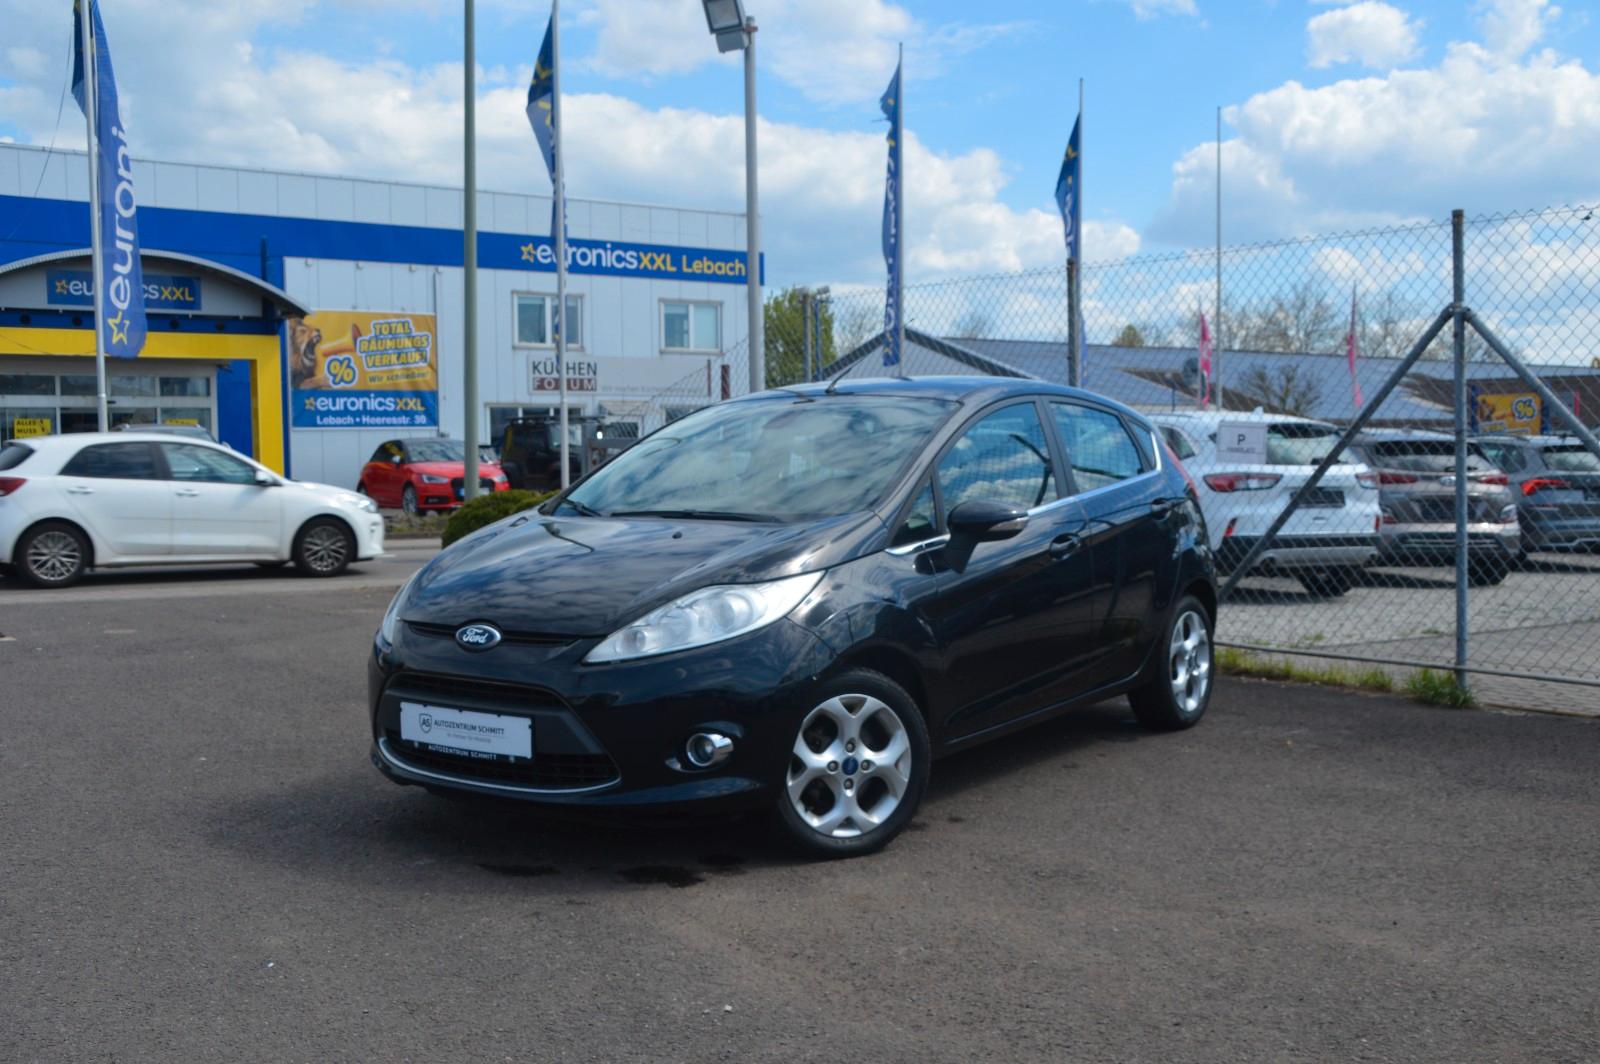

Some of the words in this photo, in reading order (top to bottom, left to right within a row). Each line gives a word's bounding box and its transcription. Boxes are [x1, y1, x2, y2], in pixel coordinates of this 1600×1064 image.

[682, 255, 746, 276] Lebach
[374, 322, 411, 335] TOTAL
[360, 335, 429, 352] RÄUMUNGS
[534, 378, 596, 391] FOUM
[316, 415, 354, 425] Lebach
[1237, 433, 1246, 446] P
[462, 627, 489, 644] Ford
[434, 719, 477, 732] AUTOZENTRUM
[478, 725, 505, 736] SCHMITT
[428, 744, 469, 757] AUTOZENTRUM
[470, 750, 497, 761] SCHMITT
